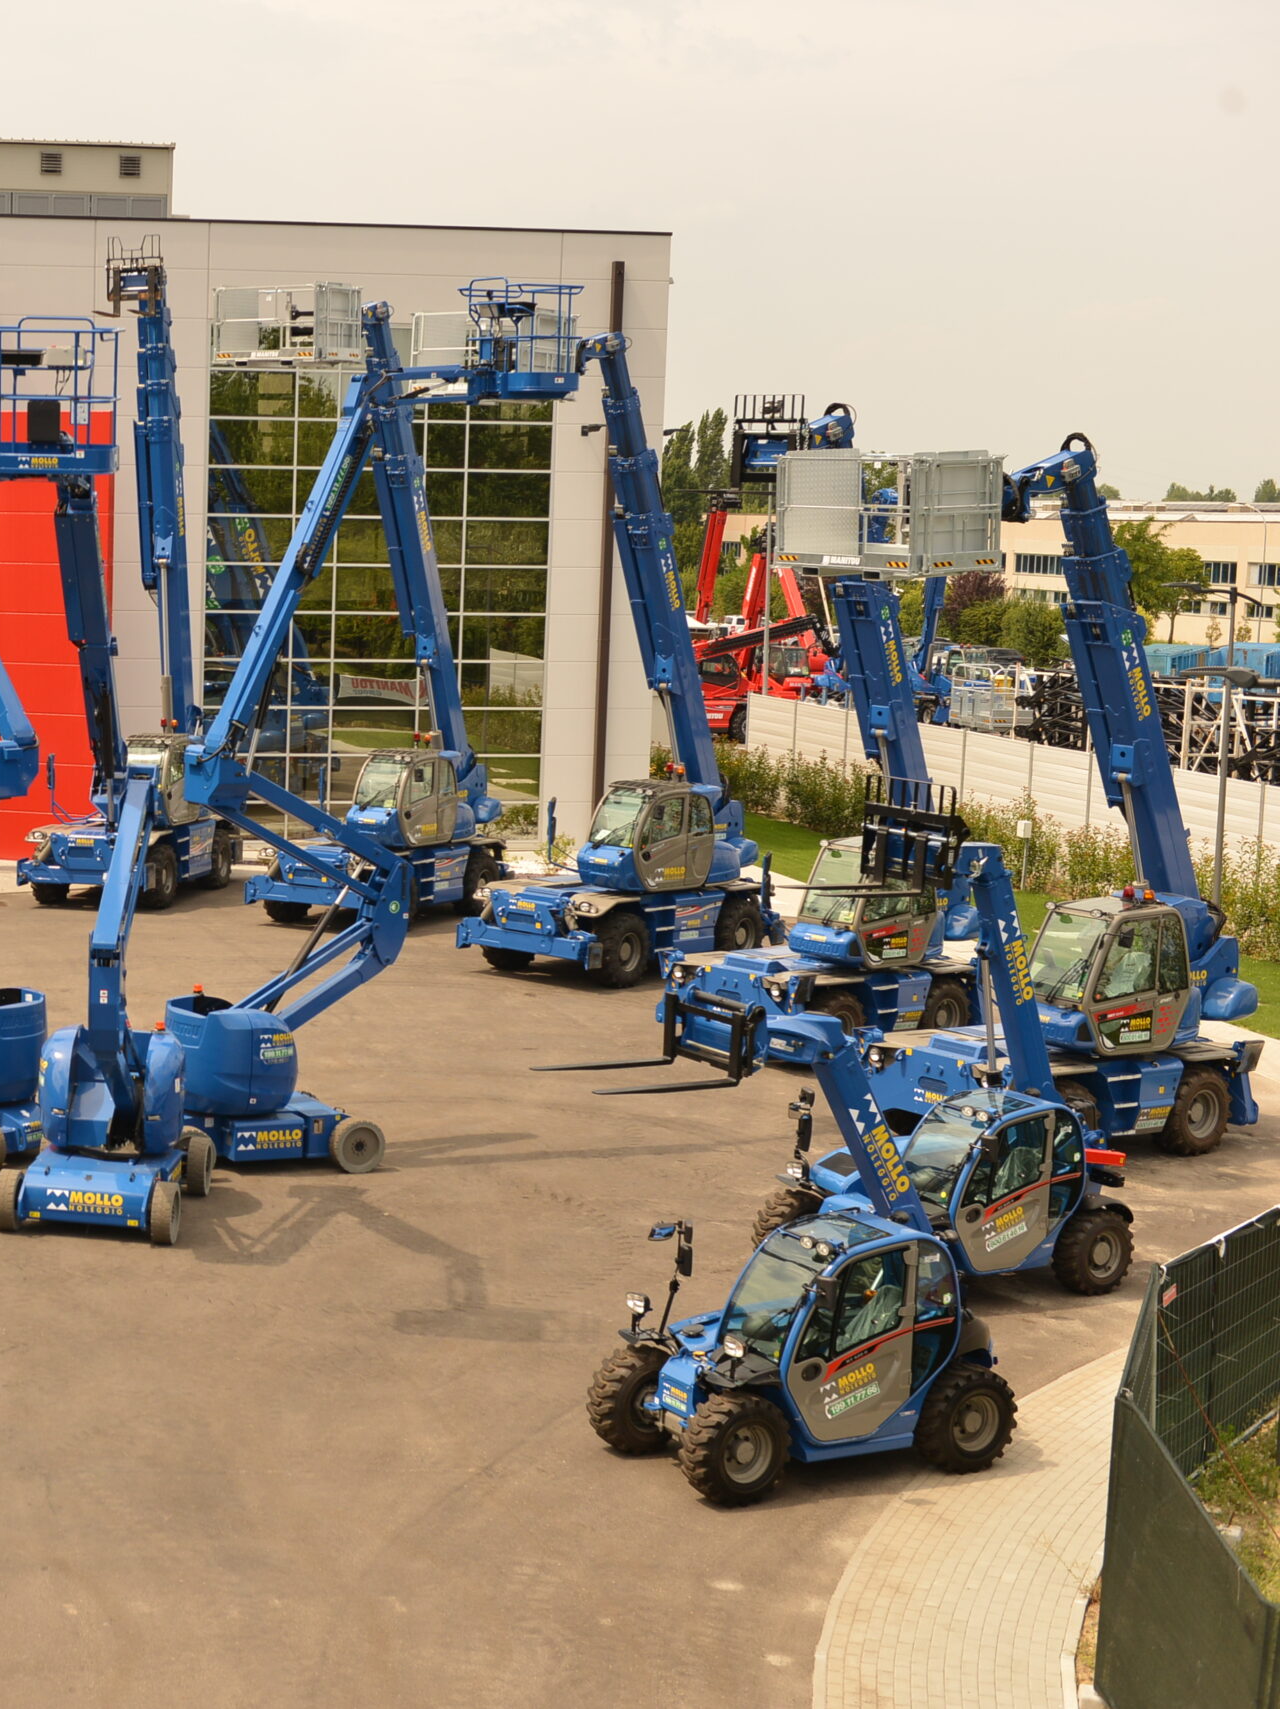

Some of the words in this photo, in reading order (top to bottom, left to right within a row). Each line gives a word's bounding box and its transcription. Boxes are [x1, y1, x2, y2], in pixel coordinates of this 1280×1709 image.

[31, 456, 58, 464] MOLLO
[418, 511, 431, 552] MOLLO
[667, 570, 680, 609] MOLLO
[885, 640, 902, 683] MOLLO
[1132, 667, 1151, 717] MOLLO
[1004, 942, 1023, 1006] NOLEGGIO
[1012, 935, 1034, 1001] MOLLO
[1130, 1016, 1151, 1026] MOLLO
[256, 1129, 302, 1142] MOLLO
[256, 1141, 302, 1149] NOLEGGIO
[862, 1133, 897, 1202] NOLEGGIO
[871, 1123, 911, 1194] MOLLO
[69, 1191, 124, 1207] MOLLO
[69, 1205, 123, 1215] NOLEGGIO
[995, 1206, 1024, 1227] MOLLO
[837, 1363, 875, 1388] MOLLO
